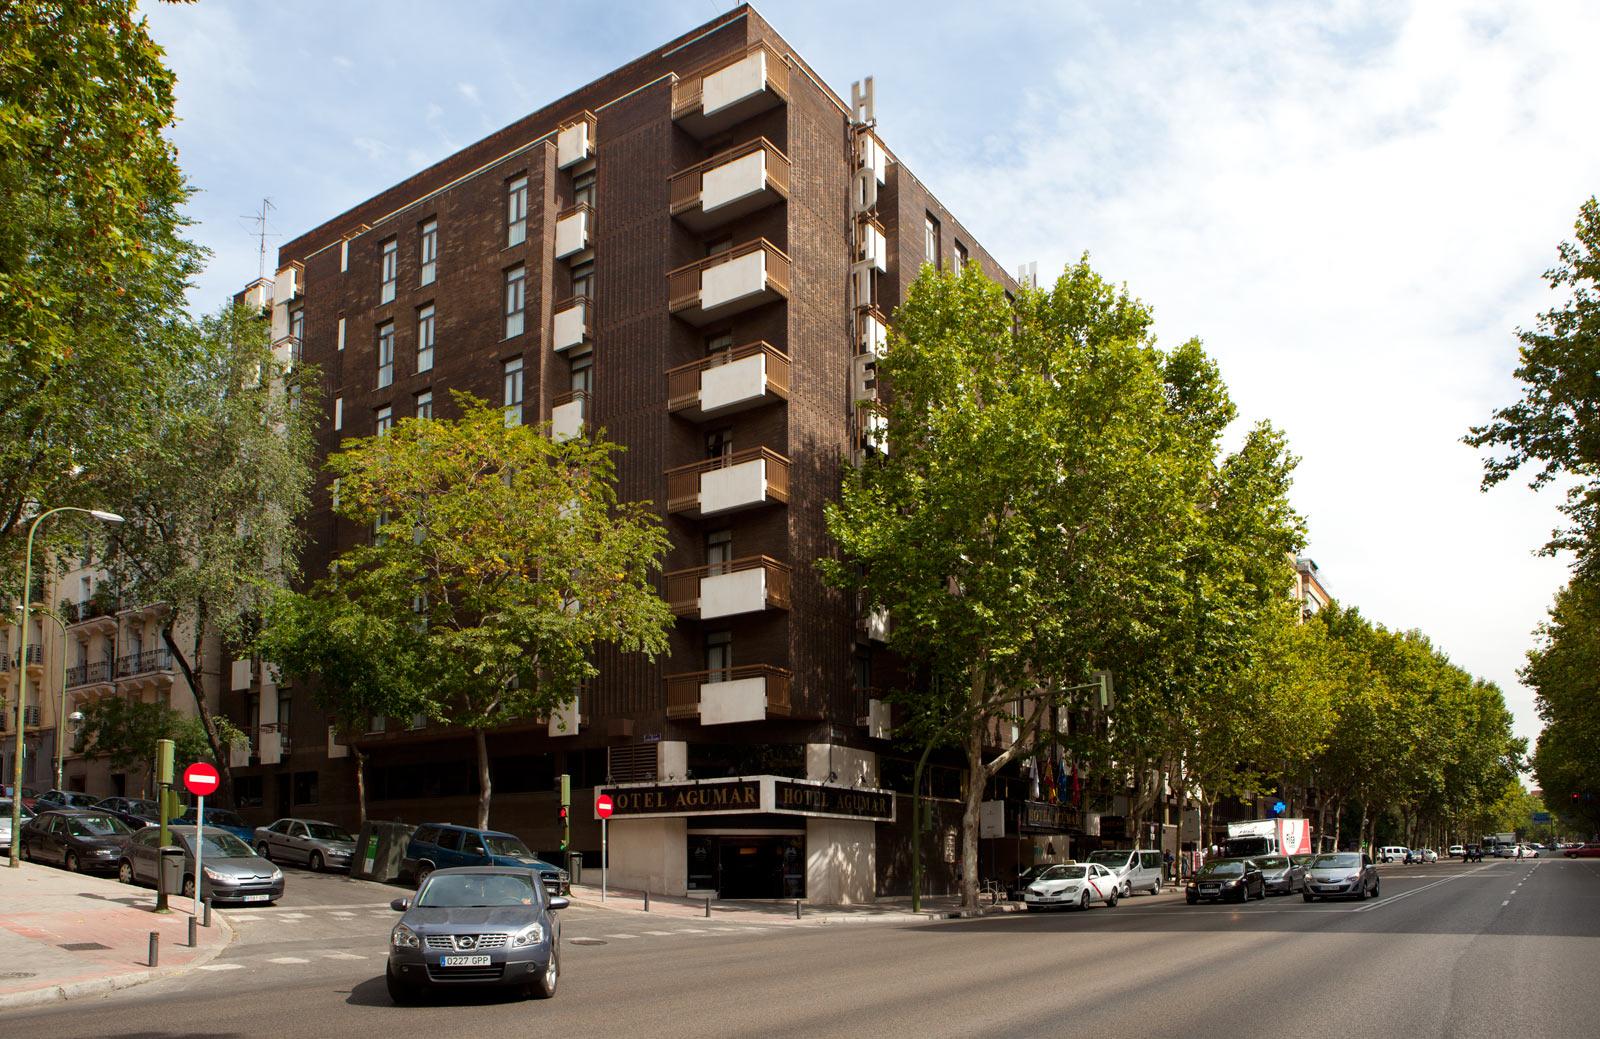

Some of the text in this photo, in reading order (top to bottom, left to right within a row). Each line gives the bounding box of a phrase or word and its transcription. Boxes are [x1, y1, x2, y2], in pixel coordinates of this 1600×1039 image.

[610, 786, 756, 809] OTEL AGUMAR
[783, 787, 830, 807] HOTEL
[446, 956, 489, 966] 0227 GPP
